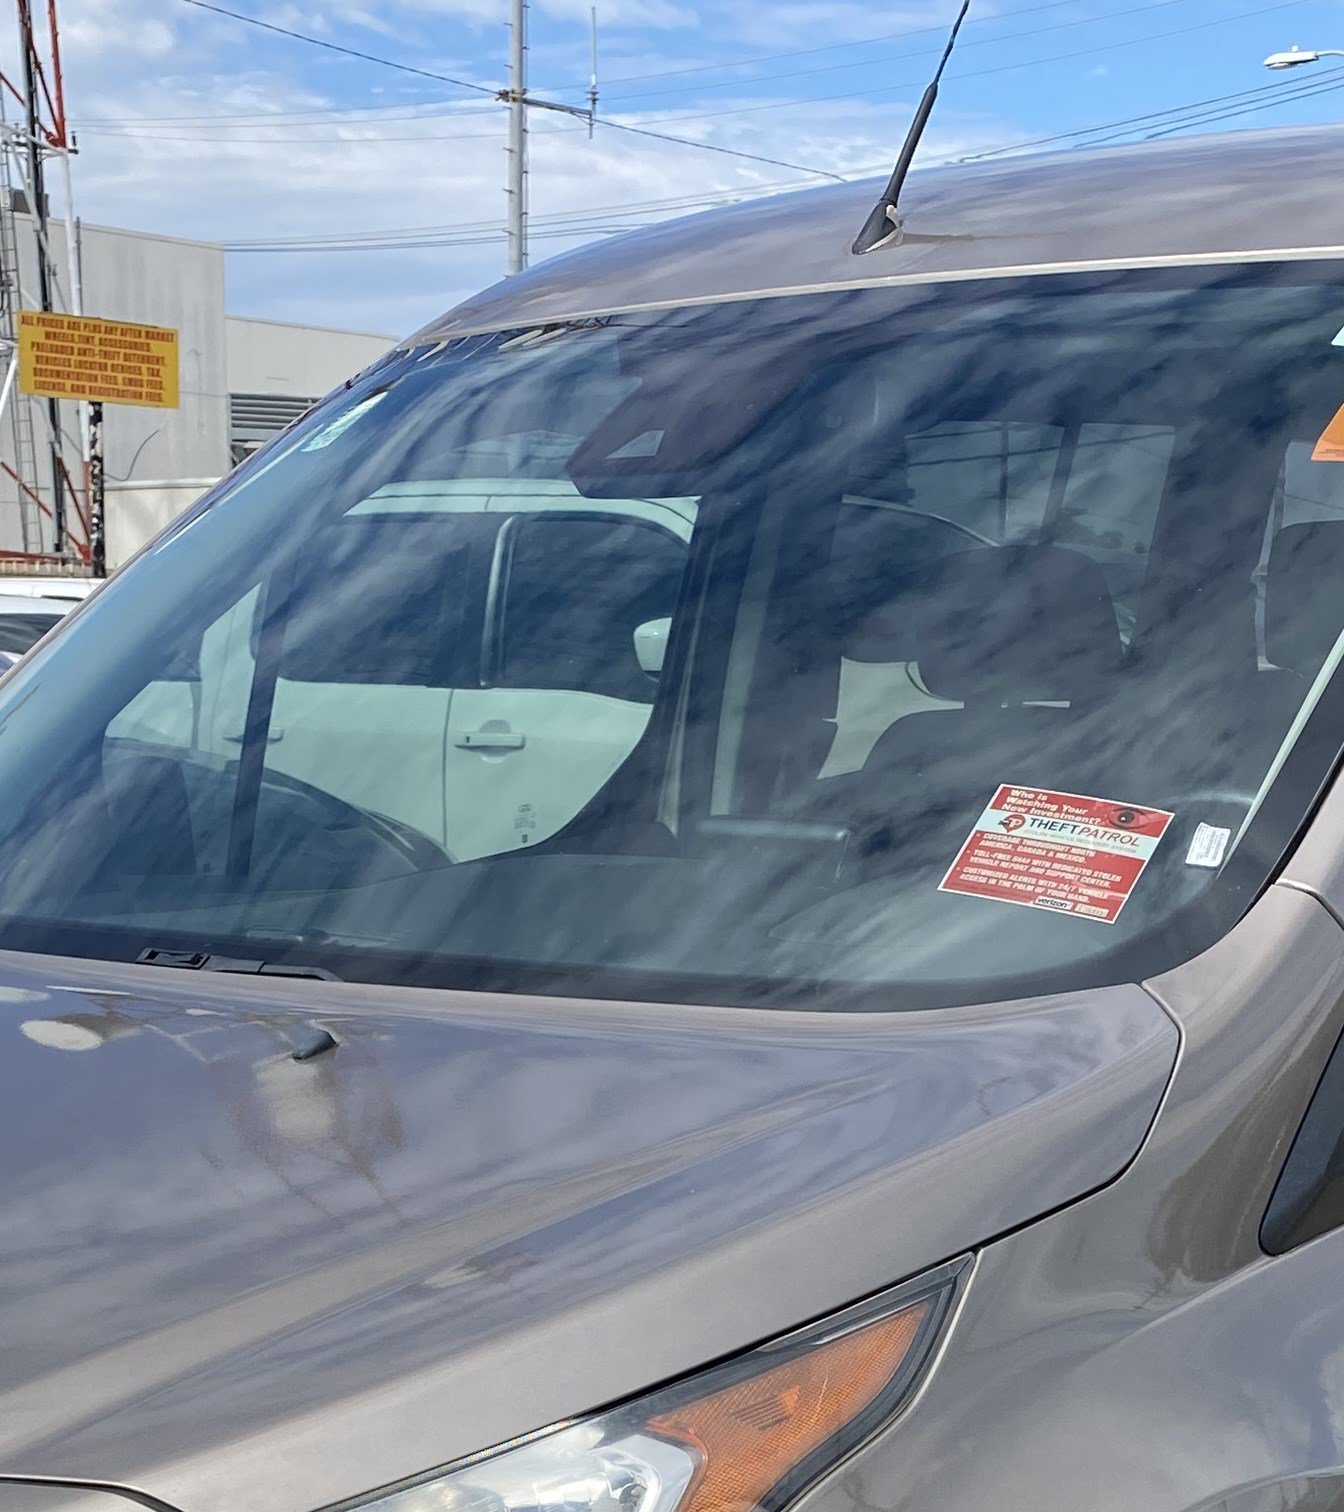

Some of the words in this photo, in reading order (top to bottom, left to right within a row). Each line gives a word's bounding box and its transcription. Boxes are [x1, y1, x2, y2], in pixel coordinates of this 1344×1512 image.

[1010, 789, 1035, 798] Who
[1002, 803, 1028, 813] New
[1029, 808, 1101, 825] Investment?
[1006, 796, 1058, 810] Watching
[1060, 805, 1088, 815] Your
[999, 862, 1028, 872] REPORT
[1045, 871, 1079, 881] SUPPORT
[1037, 898, 1068, 908] verizon
